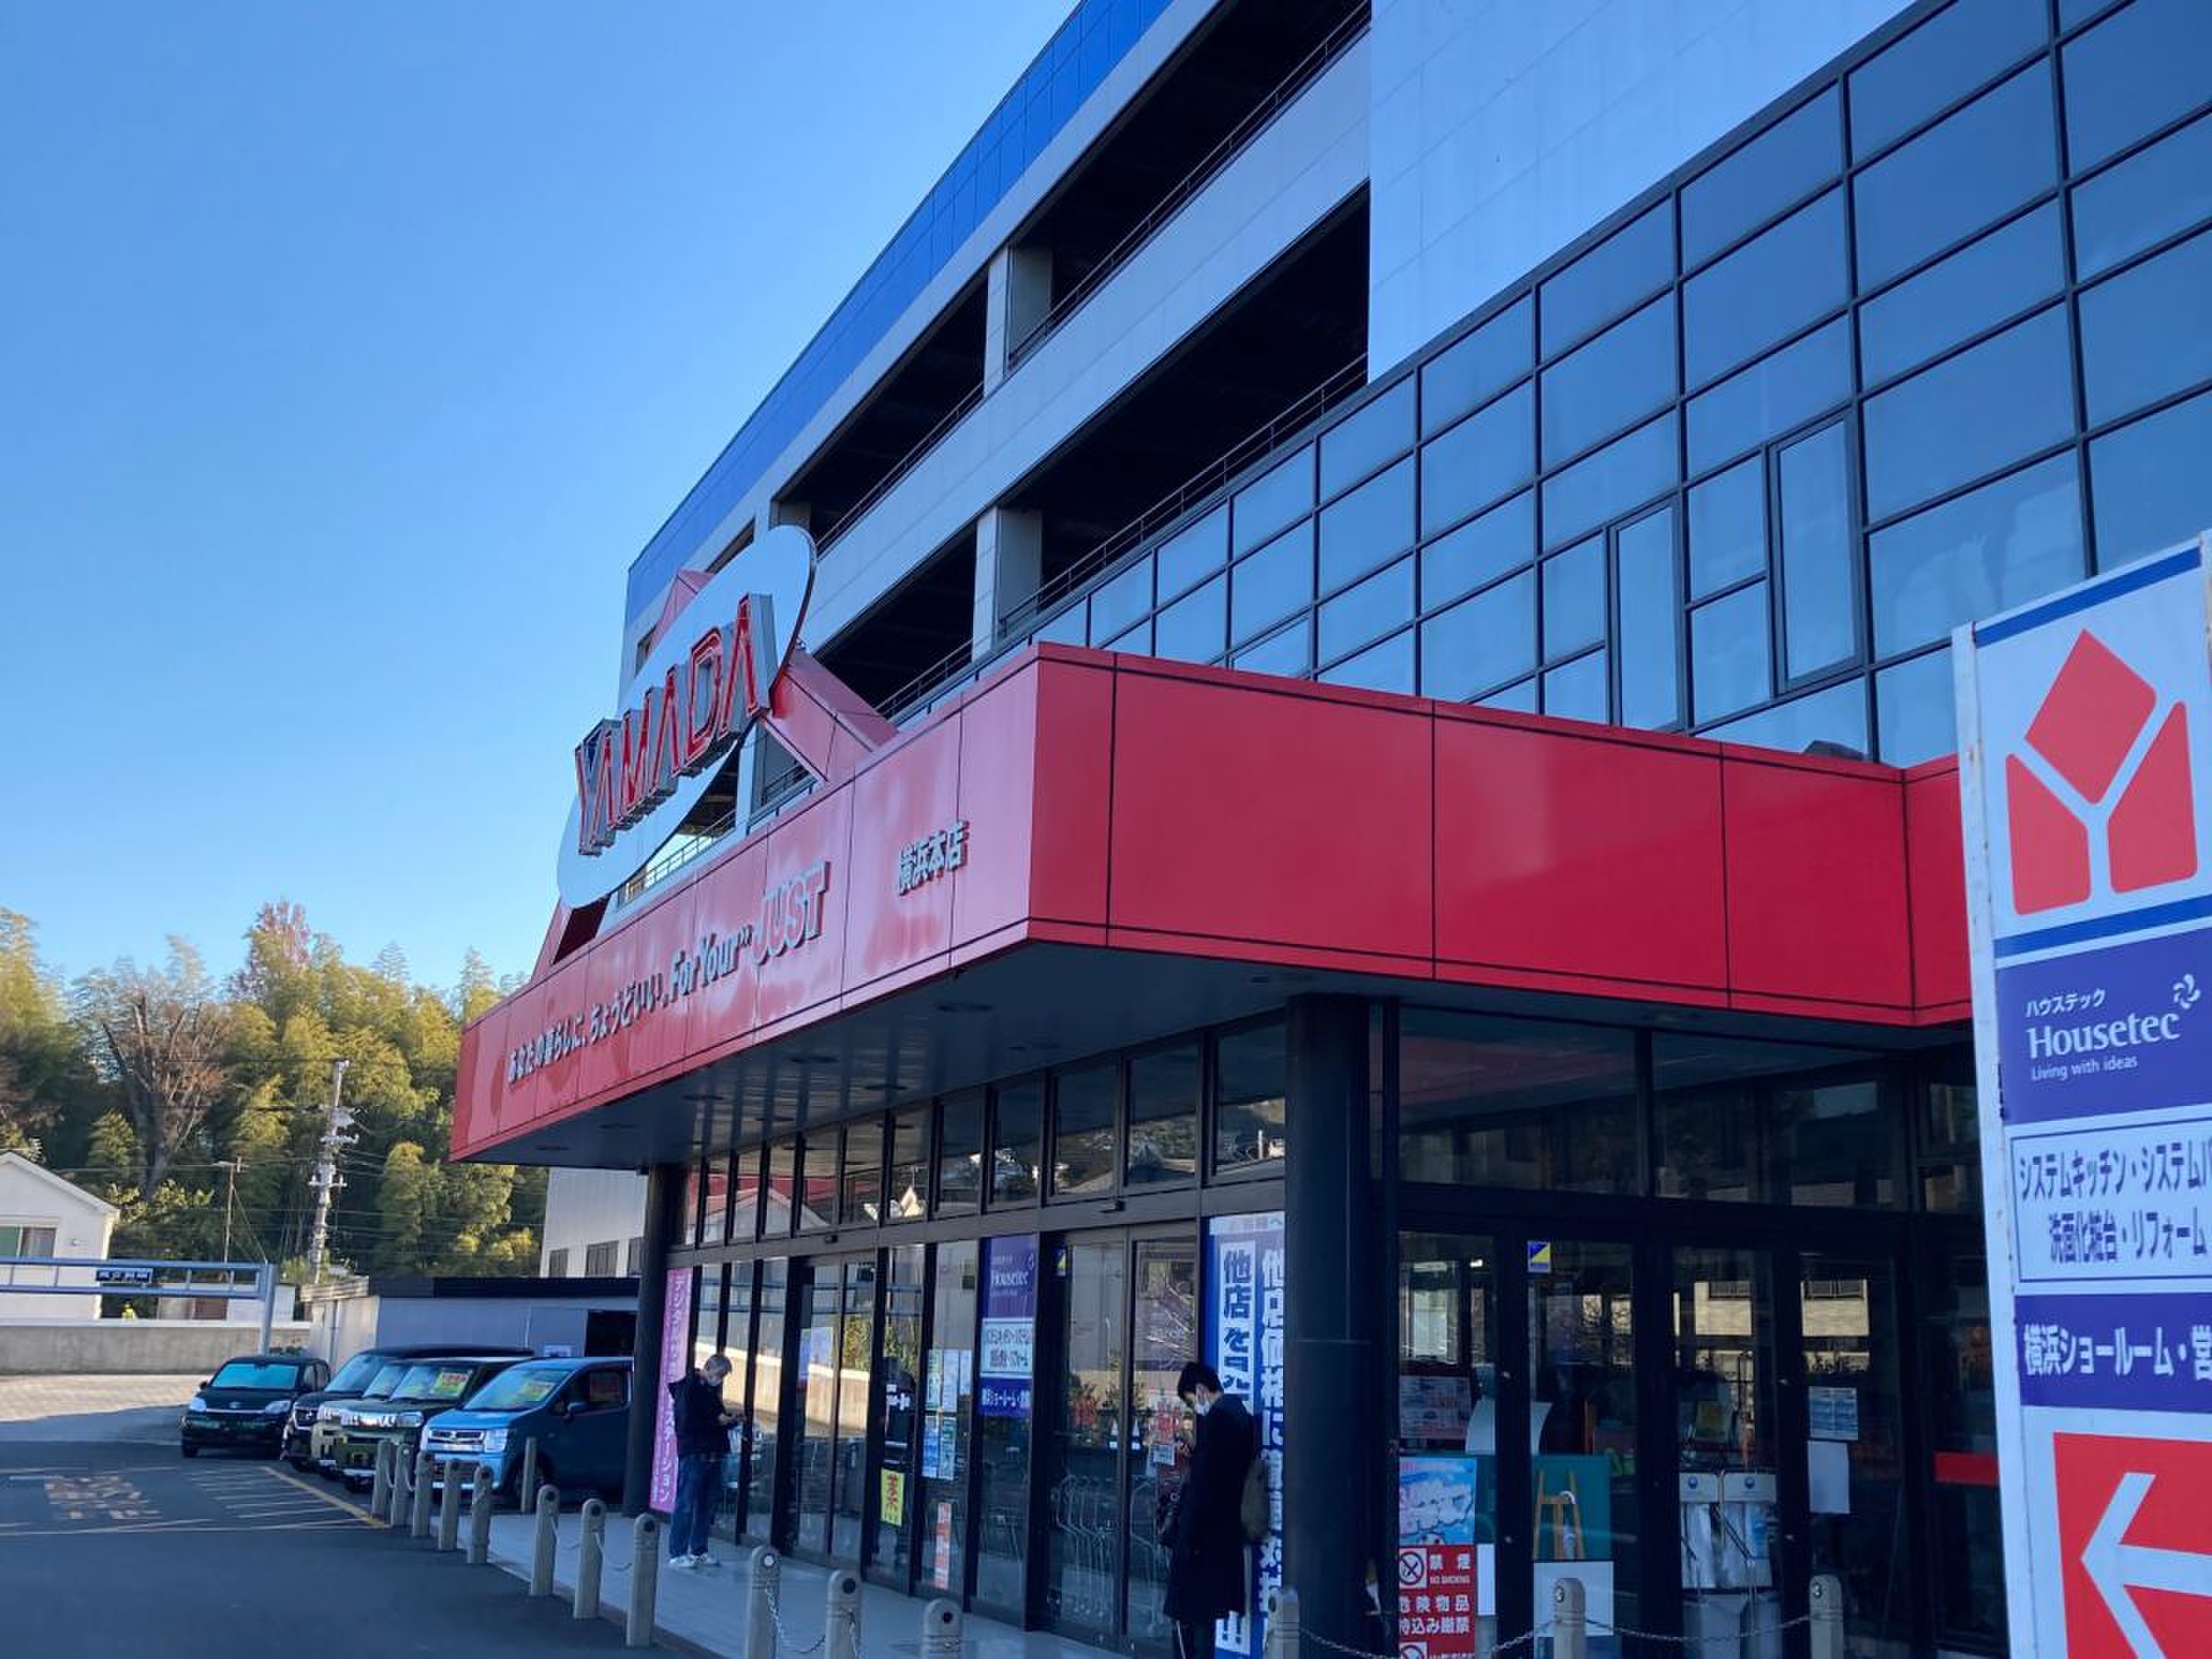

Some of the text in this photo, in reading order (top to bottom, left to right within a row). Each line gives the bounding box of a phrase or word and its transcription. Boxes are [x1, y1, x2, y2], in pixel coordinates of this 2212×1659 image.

[573, 593, 774, 856] YAMADA
[899, 819, 970, 897] 横浜本店
[2025, 988, 2107, 1018] ハウステック
[2026, 1012, 2182, 1060] Housetec
[2031, 1055, 2139, 1082] Living with ideas
[2049, 1206, 2207, 1265] 洗面化粧台・リフォーム
